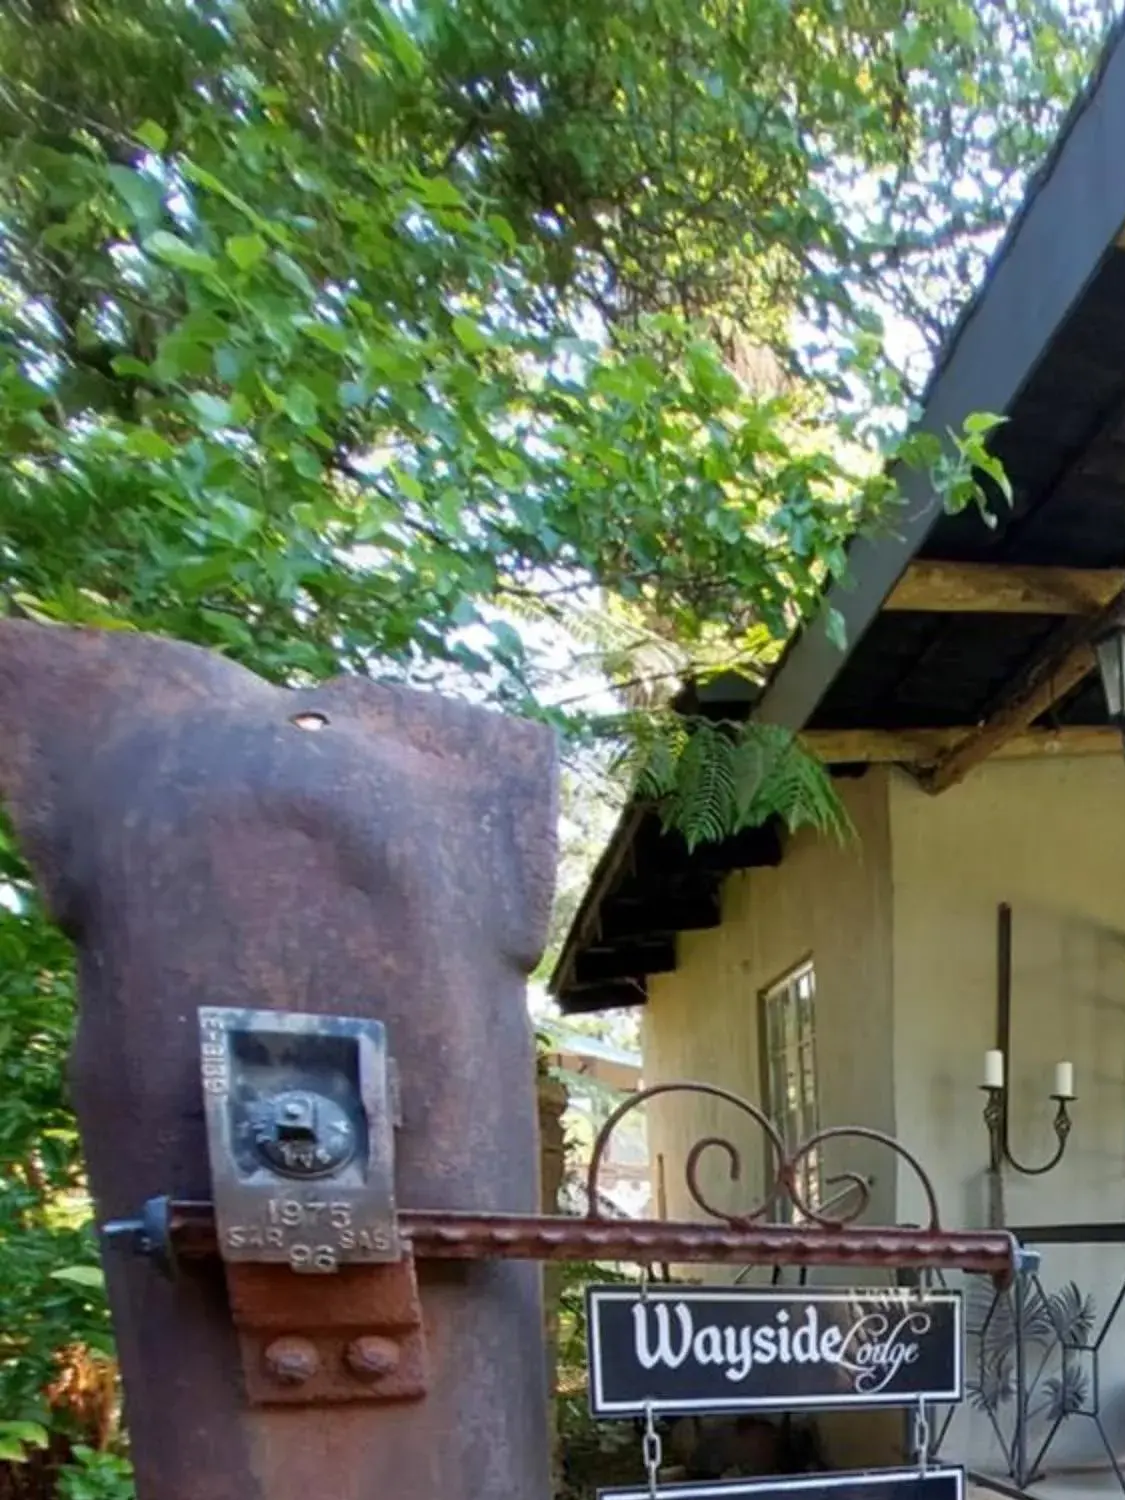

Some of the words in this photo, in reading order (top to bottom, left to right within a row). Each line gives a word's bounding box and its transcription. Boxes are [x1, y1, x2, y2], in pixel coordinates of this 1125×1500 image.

[268, 1199, 352, 1228] 1975
[631, 1301, 842, 1382] Wayside
[836, 1312, 931, 1394] Lodge
